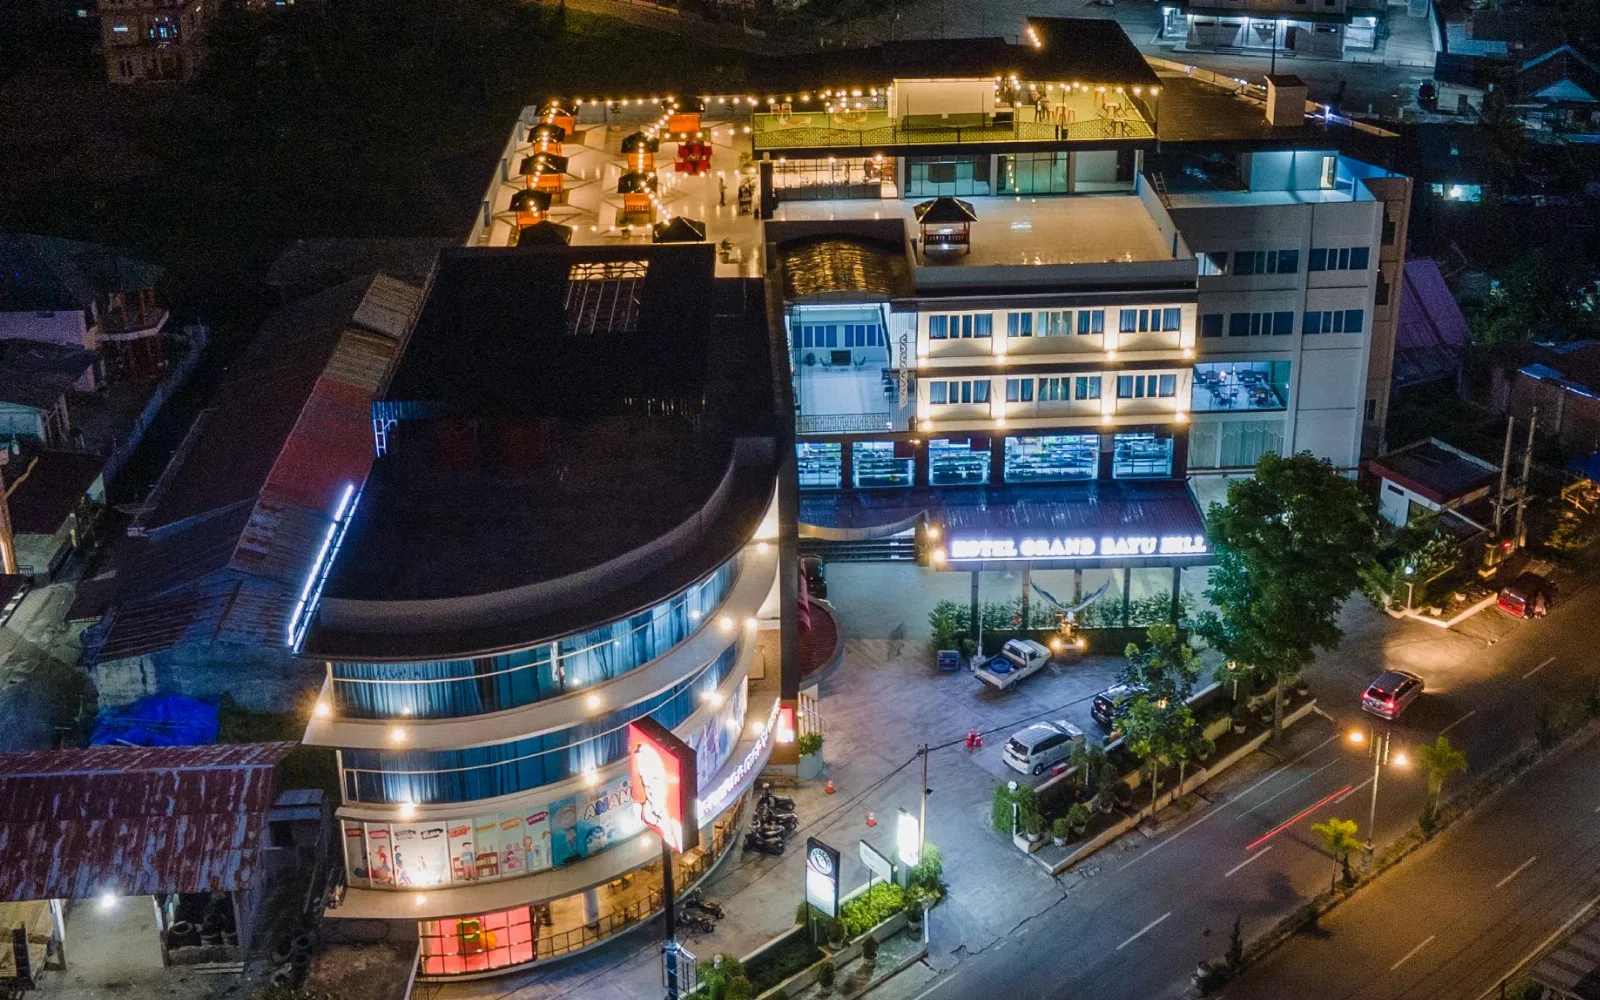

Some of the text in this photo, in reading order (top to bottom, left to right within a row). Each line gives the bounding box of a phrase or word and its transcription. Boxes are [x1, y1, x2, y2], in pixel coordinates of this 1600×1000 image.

[952, 540, 1017, 557] HOTEL
[1020, 538, 1095, 556] GRAND
[1160, 536, 1206, 553] HILL
